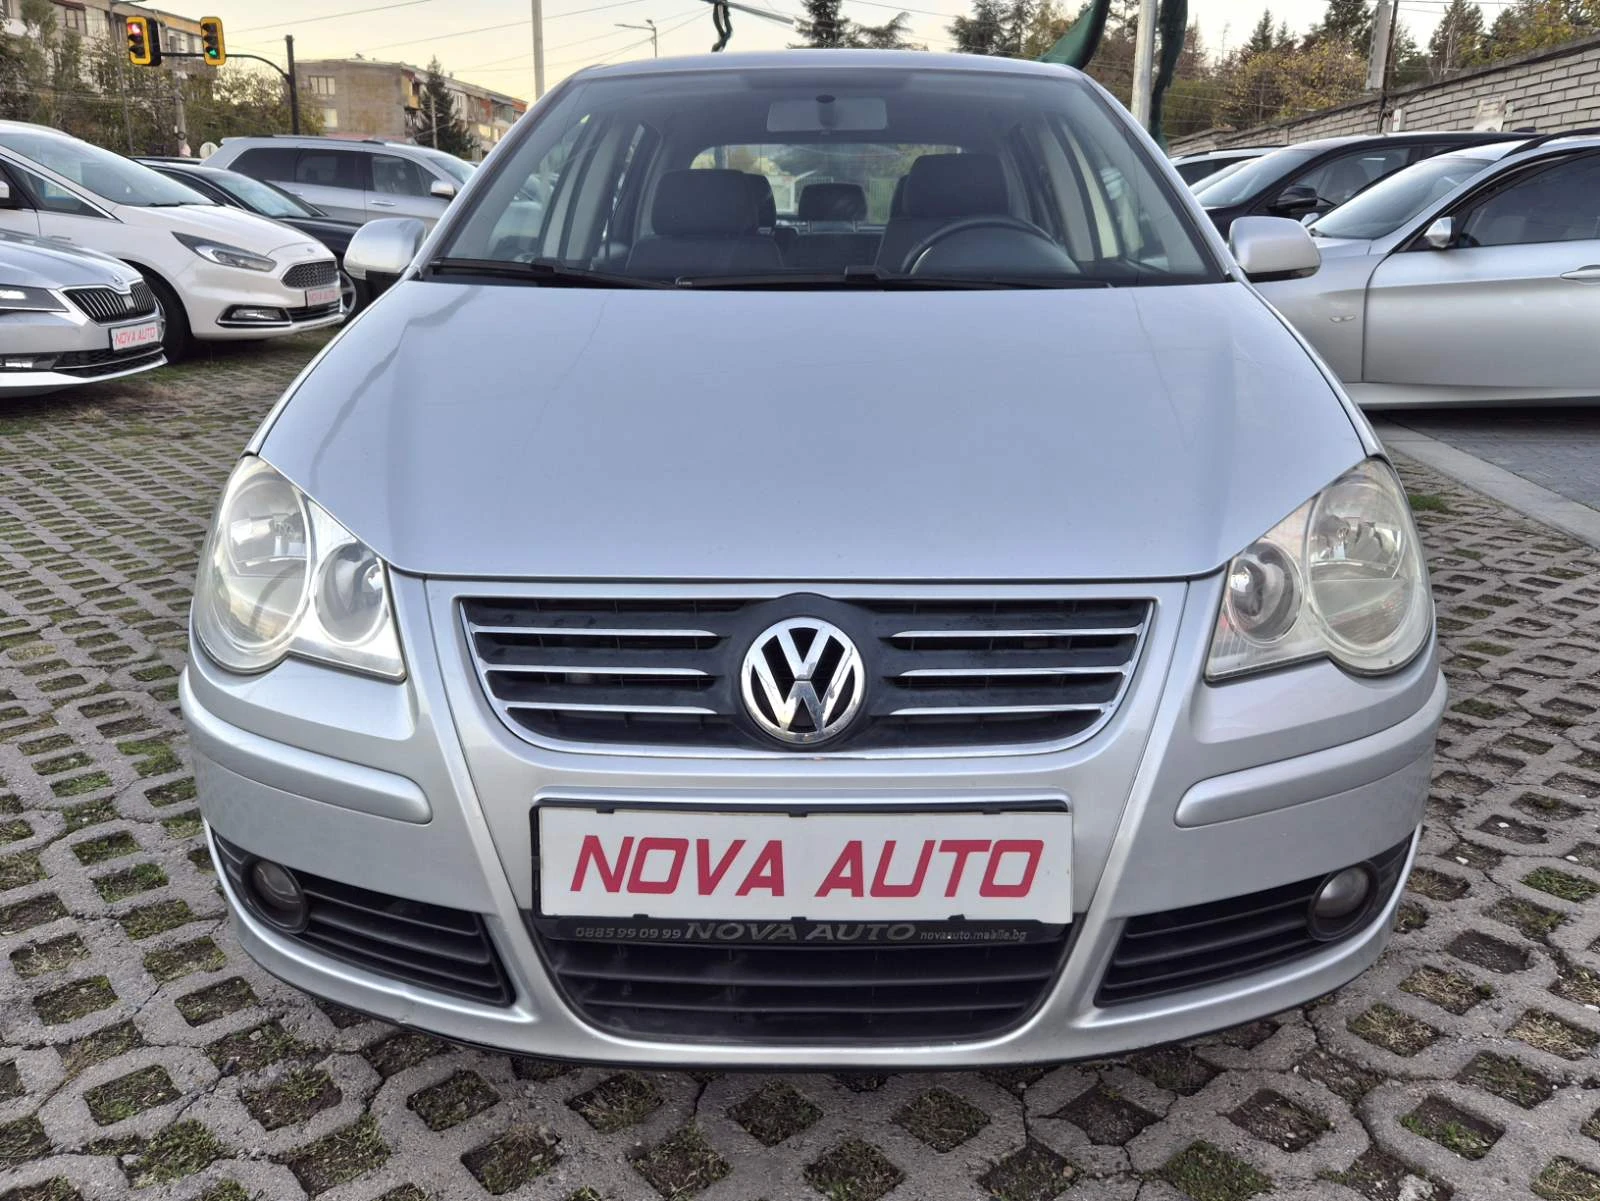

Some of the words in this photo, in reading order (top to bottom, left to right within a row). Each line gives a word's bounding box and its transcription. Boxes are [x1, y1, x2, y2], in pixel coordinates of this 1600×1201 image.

[115, 331, 136, 346] NOVA
[137, 326, 156, 342] AUTO
[741, 617, 865, 743] VW
[570, 834, 785, 897] NOVA
[814, 838, 1045, 899] AUTO
[575, 927, 615, 938] 0885
[617, 928, 637, 938] 99
[639, 928, 659, 939] 09
[662, 928, 681, 939] 99
[684, 922, 798, 941] NOVA
[804, 923, 917, 941] AUTO
